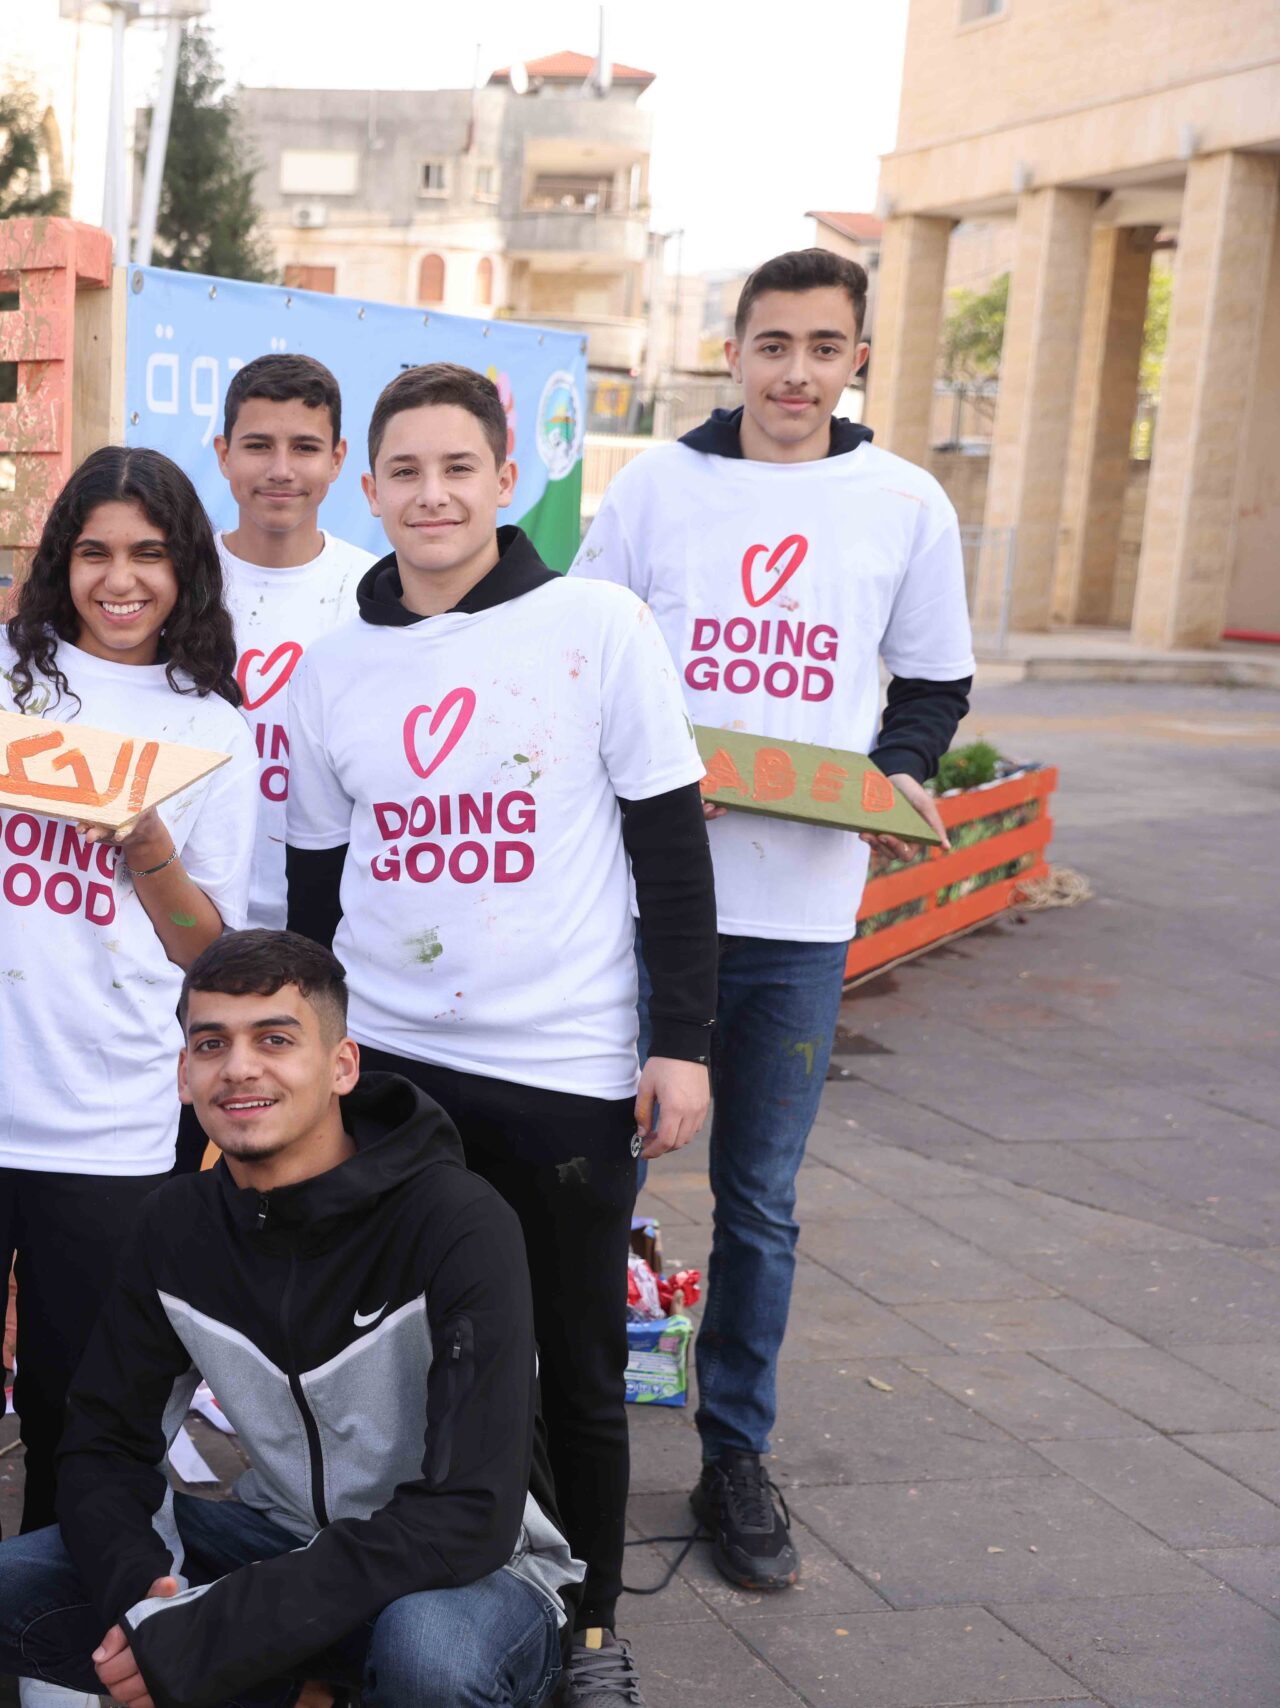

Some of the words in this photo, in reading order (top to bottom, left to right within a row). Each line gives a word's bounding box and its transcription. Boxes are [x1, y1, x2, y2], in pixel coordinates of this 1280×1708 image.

[691, 617, 839, 662] DOING
[684, 656, 834, 702] GOOD
[699, 747, 895, 813] ABED
[372, 790, 537, 841] DOING
[370, 840, 535, 884] GOOD
